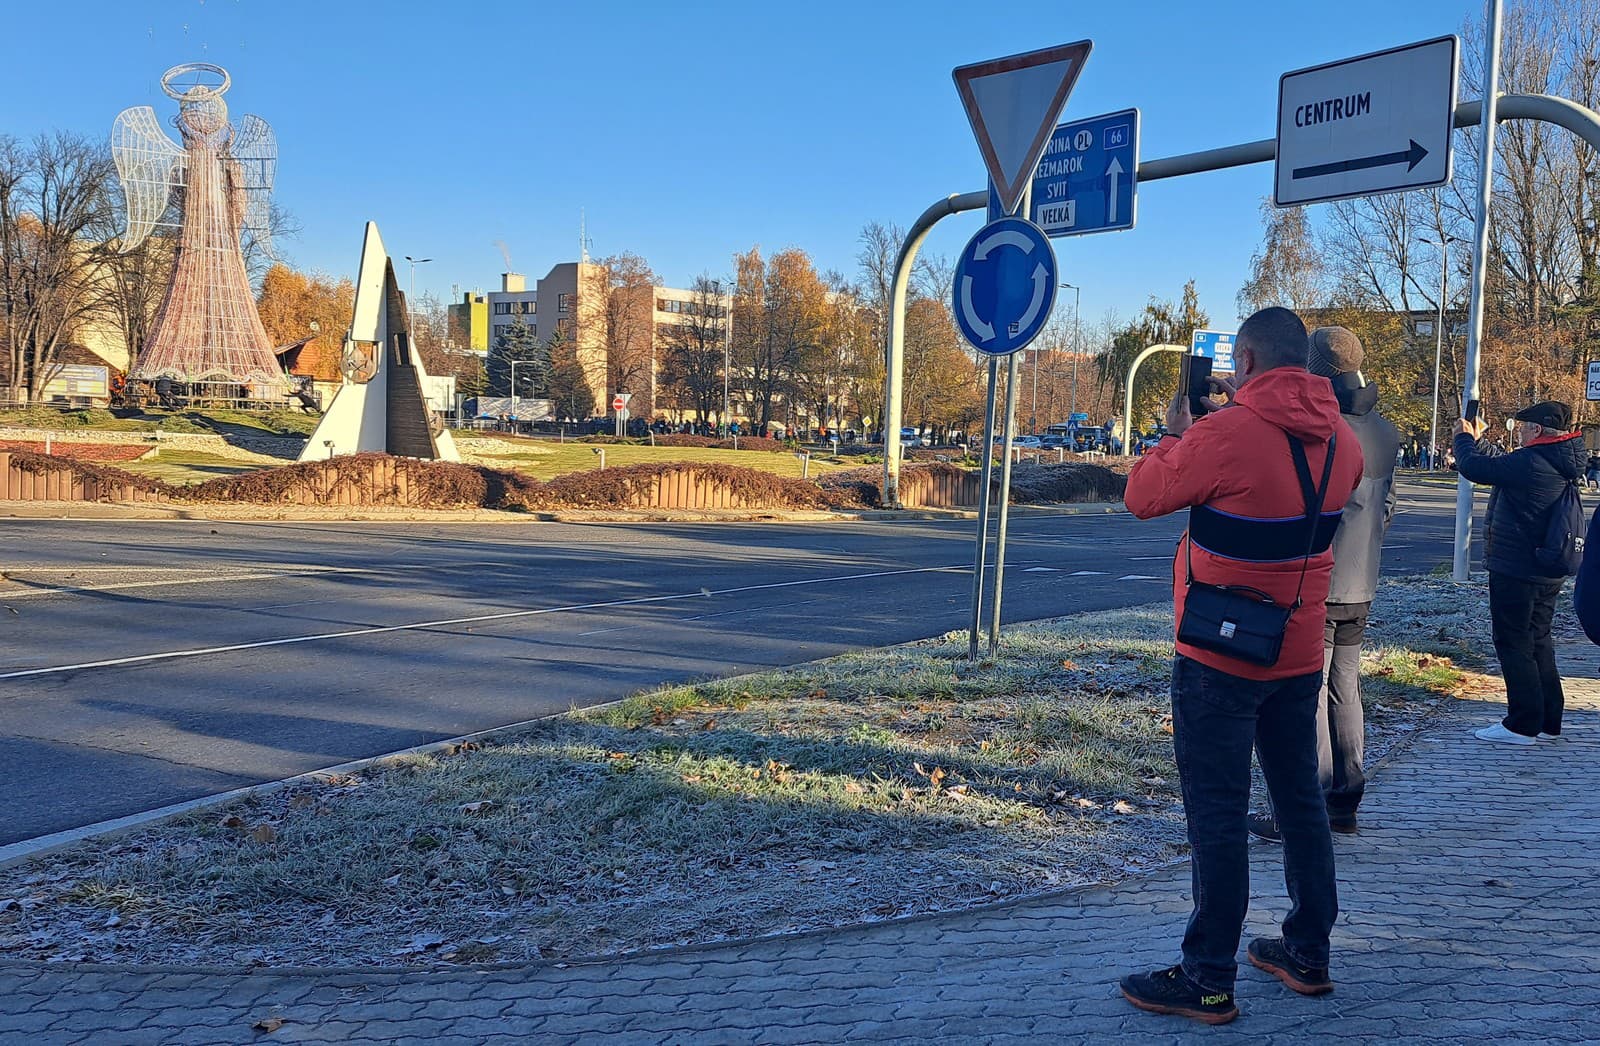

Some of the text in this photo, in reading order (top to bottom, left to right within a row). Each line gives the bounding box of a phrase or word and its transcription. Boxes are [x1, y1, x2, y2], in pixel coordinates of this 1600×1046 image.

[1295, 91, 1371, 128] CENTRUM
[1077, 132, 1089, 149] PL
[1111, 130, 1122, 144] 66
[1047, 181, 1067, 199] SVIT
[1042, 202, 1070, 224] VEĽKÁ
[1201, 993, 1229, 1006] HOKA
